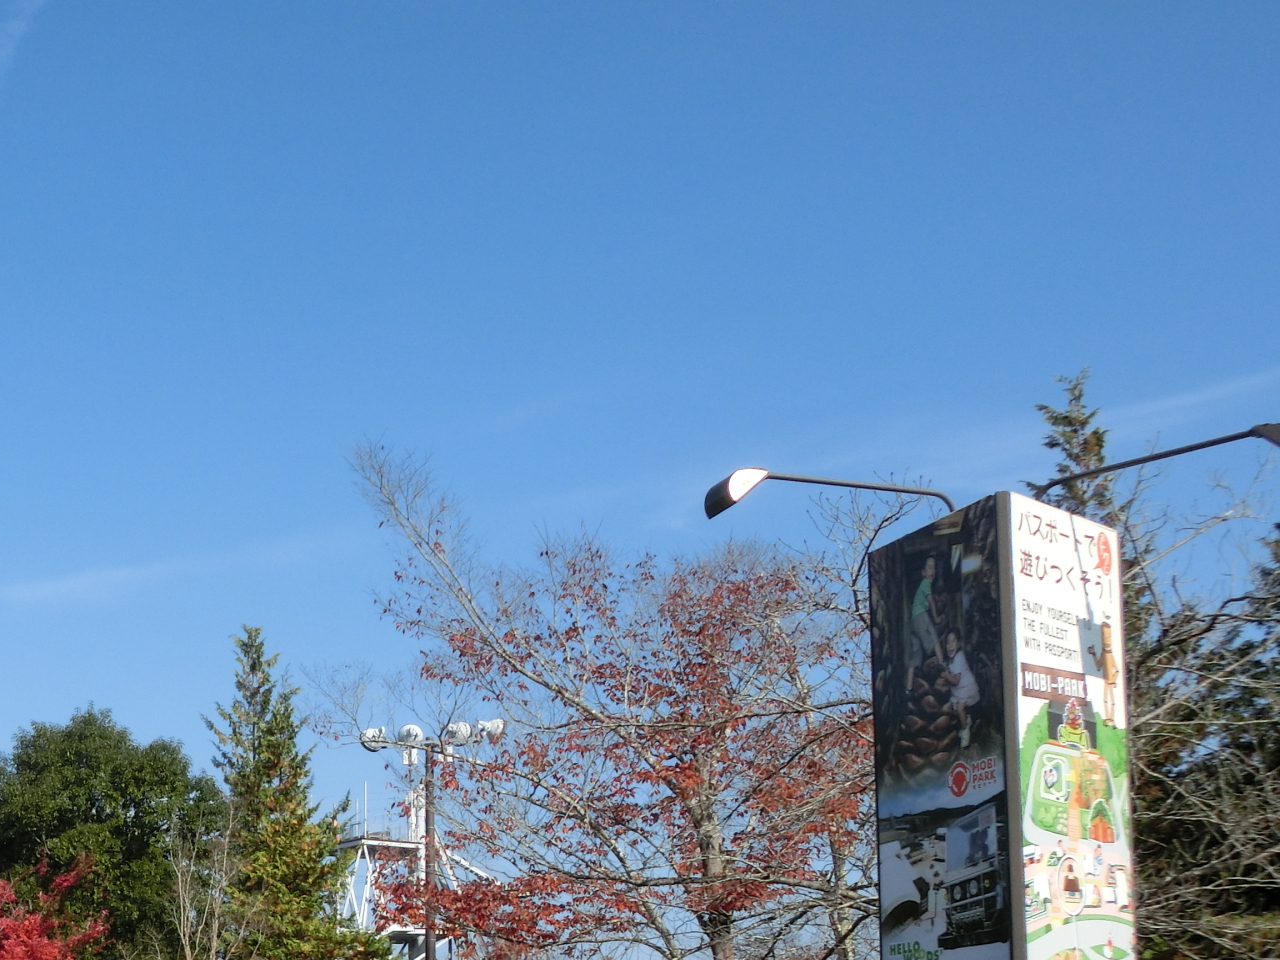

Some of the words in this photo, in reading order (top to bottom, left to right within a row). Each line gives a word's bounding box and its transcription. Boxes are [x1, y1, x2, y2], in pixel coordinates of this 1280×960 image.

[1018, 511, 1097, 558] パスポートで
[1022, 598, 1043, 616] ENJOY
[1023, 617, 1036, 633] THE
[1040, 622, 1068, 641] FULLEST
[1023, 635, 1041, 652] WITH
[1024, 670, 1086, 698] MOBI-PARK
[972, 757, 997, 773] MOBI
[972, 769, 996, 784] PARK
[889, 940, 921, 956] HELLO
